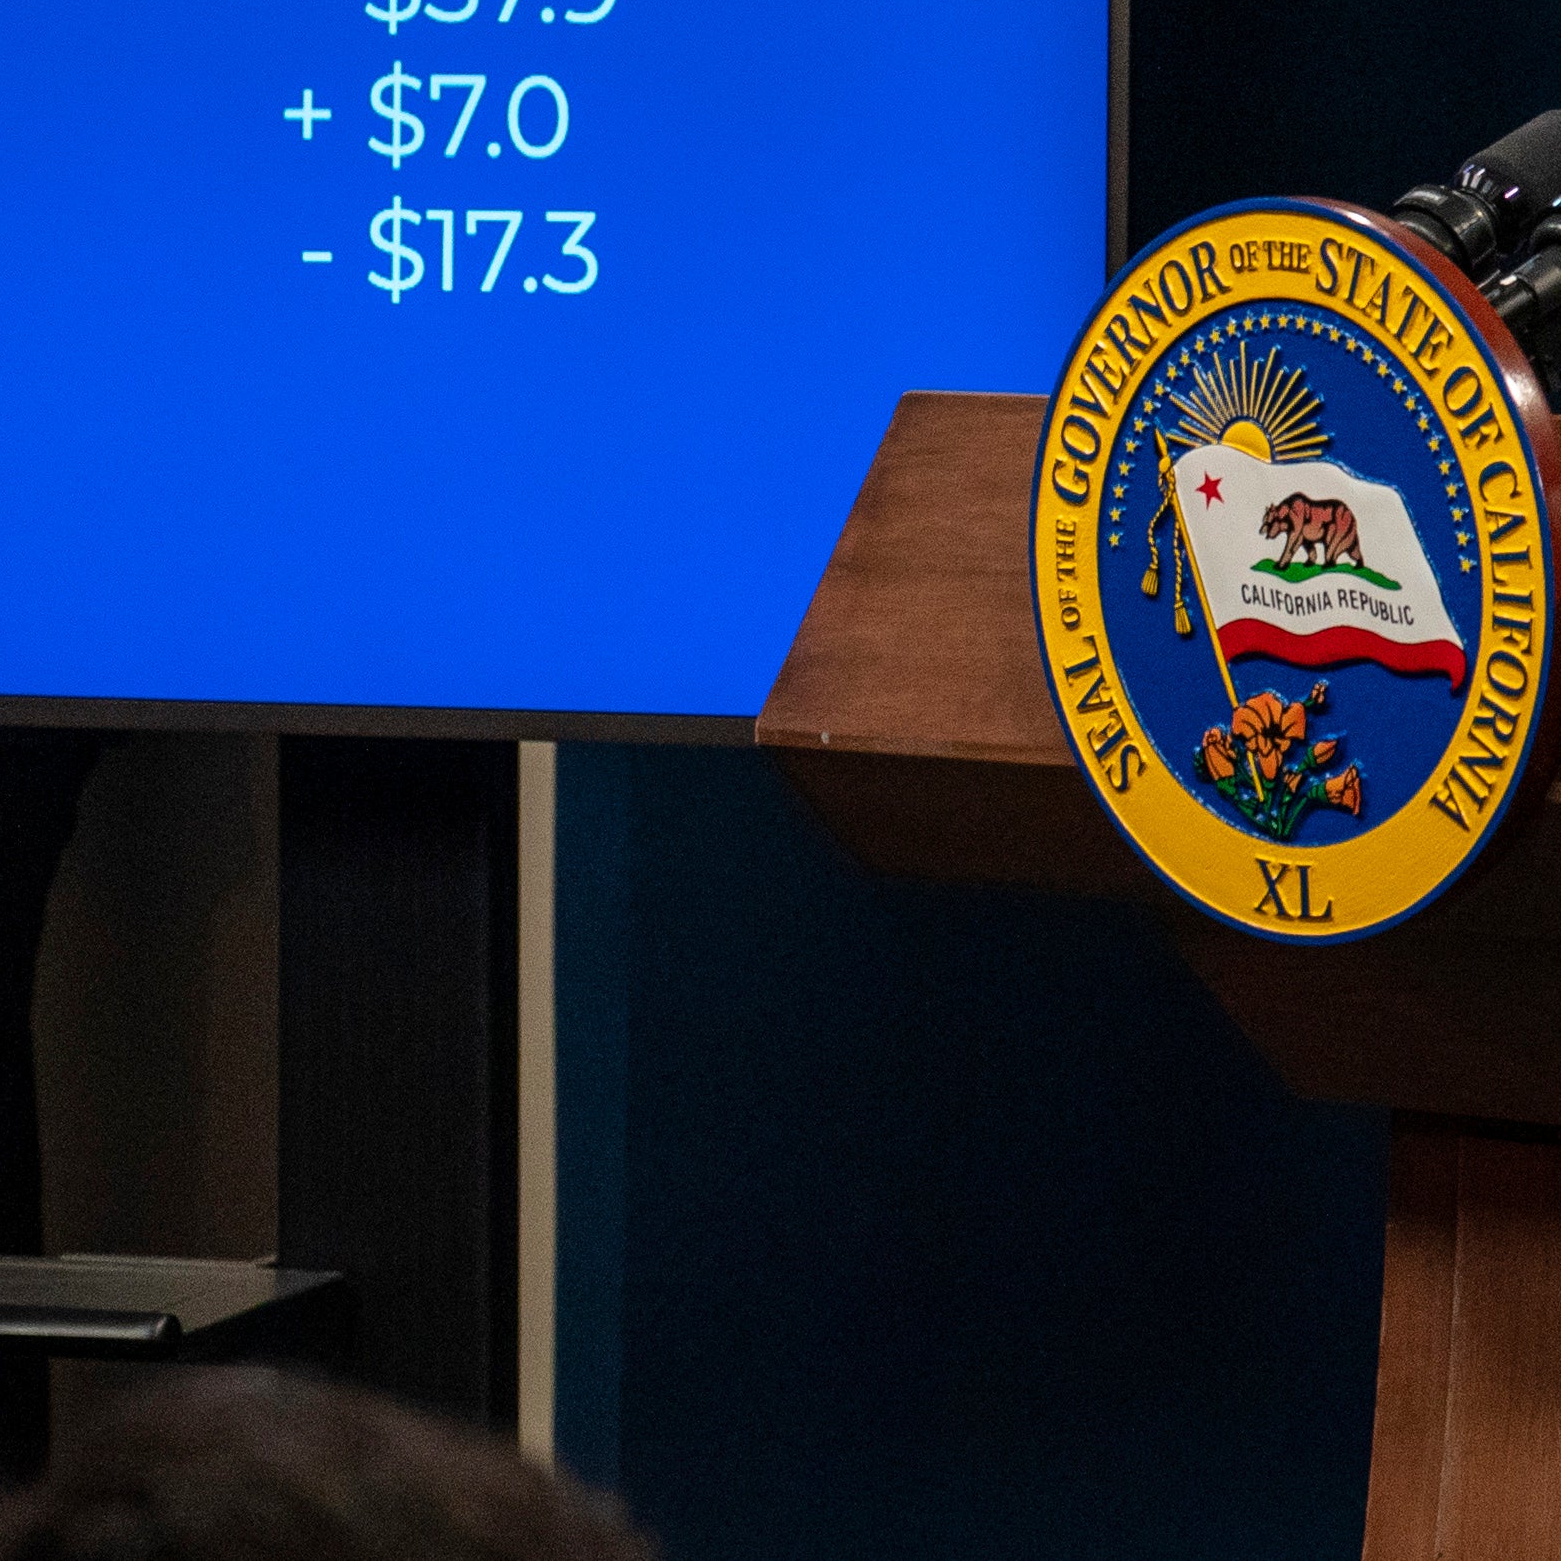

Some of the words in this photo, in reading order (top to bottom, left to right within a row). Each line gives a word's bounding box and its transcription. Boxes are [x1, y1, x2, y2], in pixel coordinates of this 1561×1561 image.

[284, 89, 331, 139] +
[368, 61, 570, 168] $7.0
[368, 195, 598, 304] $17.3
[1229, 241, 1258, 273] OF
[1260, 240, 1312, 274] THE
[1315, 237, 1453, 379] STATE
[1052, 240, 1231, 505] GOVERNOR
[1442, 365, 1503, 451] OF
[1055, 519, 1077, 584] THE
[1058, 588, 1081, 631] OF
[1241, 584, 1333, 616] CALIFORNIA
[1338, 588, 1414, 626] REPUBLIC
[1429, 460, 1533, 832] CALIFORNIA
[1063, 634, 1147, 793] SEAL
[1253, 857, 1333, 923] XL
